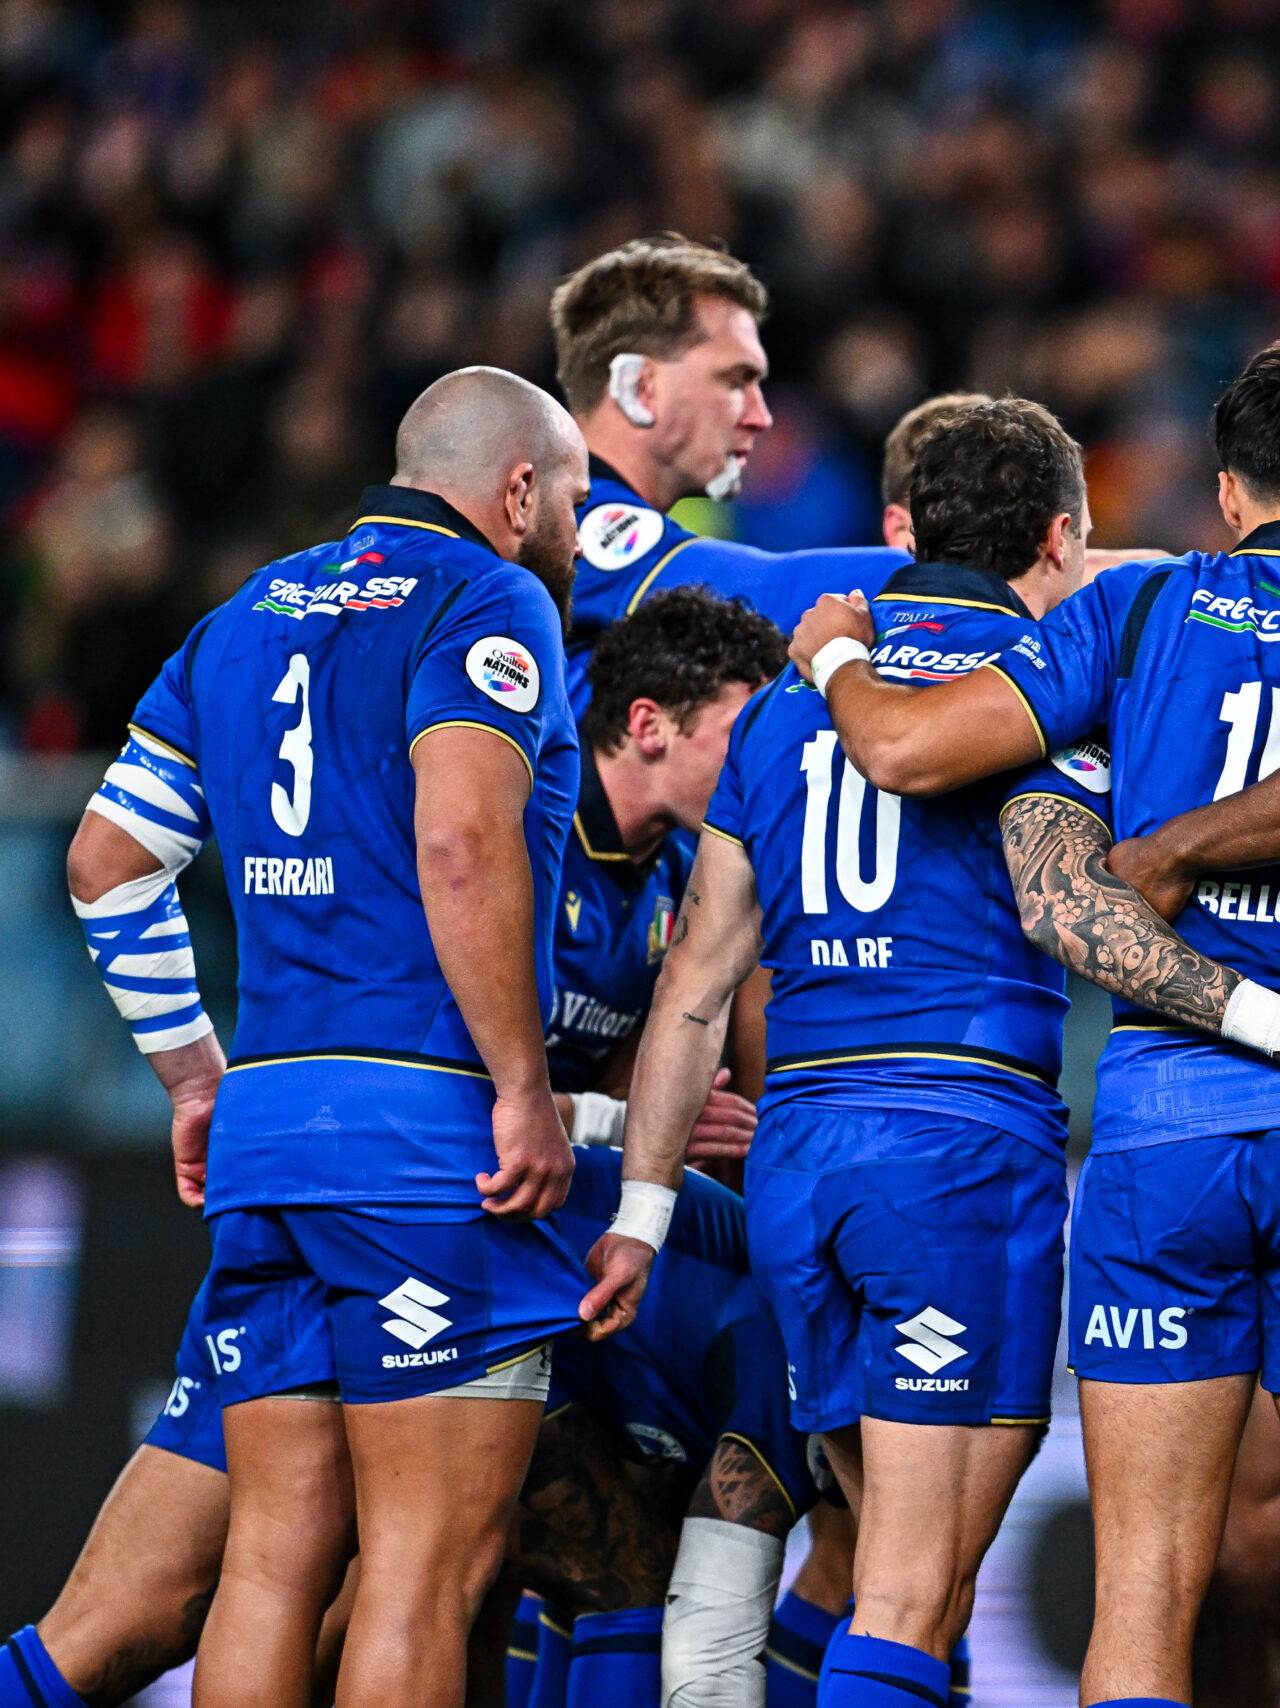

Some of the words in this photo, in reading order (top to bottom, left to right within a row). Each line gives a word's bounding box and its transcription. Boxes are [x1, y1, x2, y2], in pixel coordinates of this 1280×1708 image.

[483, 656, 530, 689] NATIONS
[492, 649, 527, 673] Quilter
[271, 653, 314, 837] 3
[800, 730, 901, 914] 10
[244, 855, 335, 895] FERRARI
[811, 939, 850, 967] DA
[562, 991, 642, 1037] Vittori
[1084, 1304, 1188, 1350] AVIS
[205, 1327, 242, 1376] IS
[382, 1347, 458, 1369] SUZUKI
[894, 1377, 969, 1392] SUZUKI
